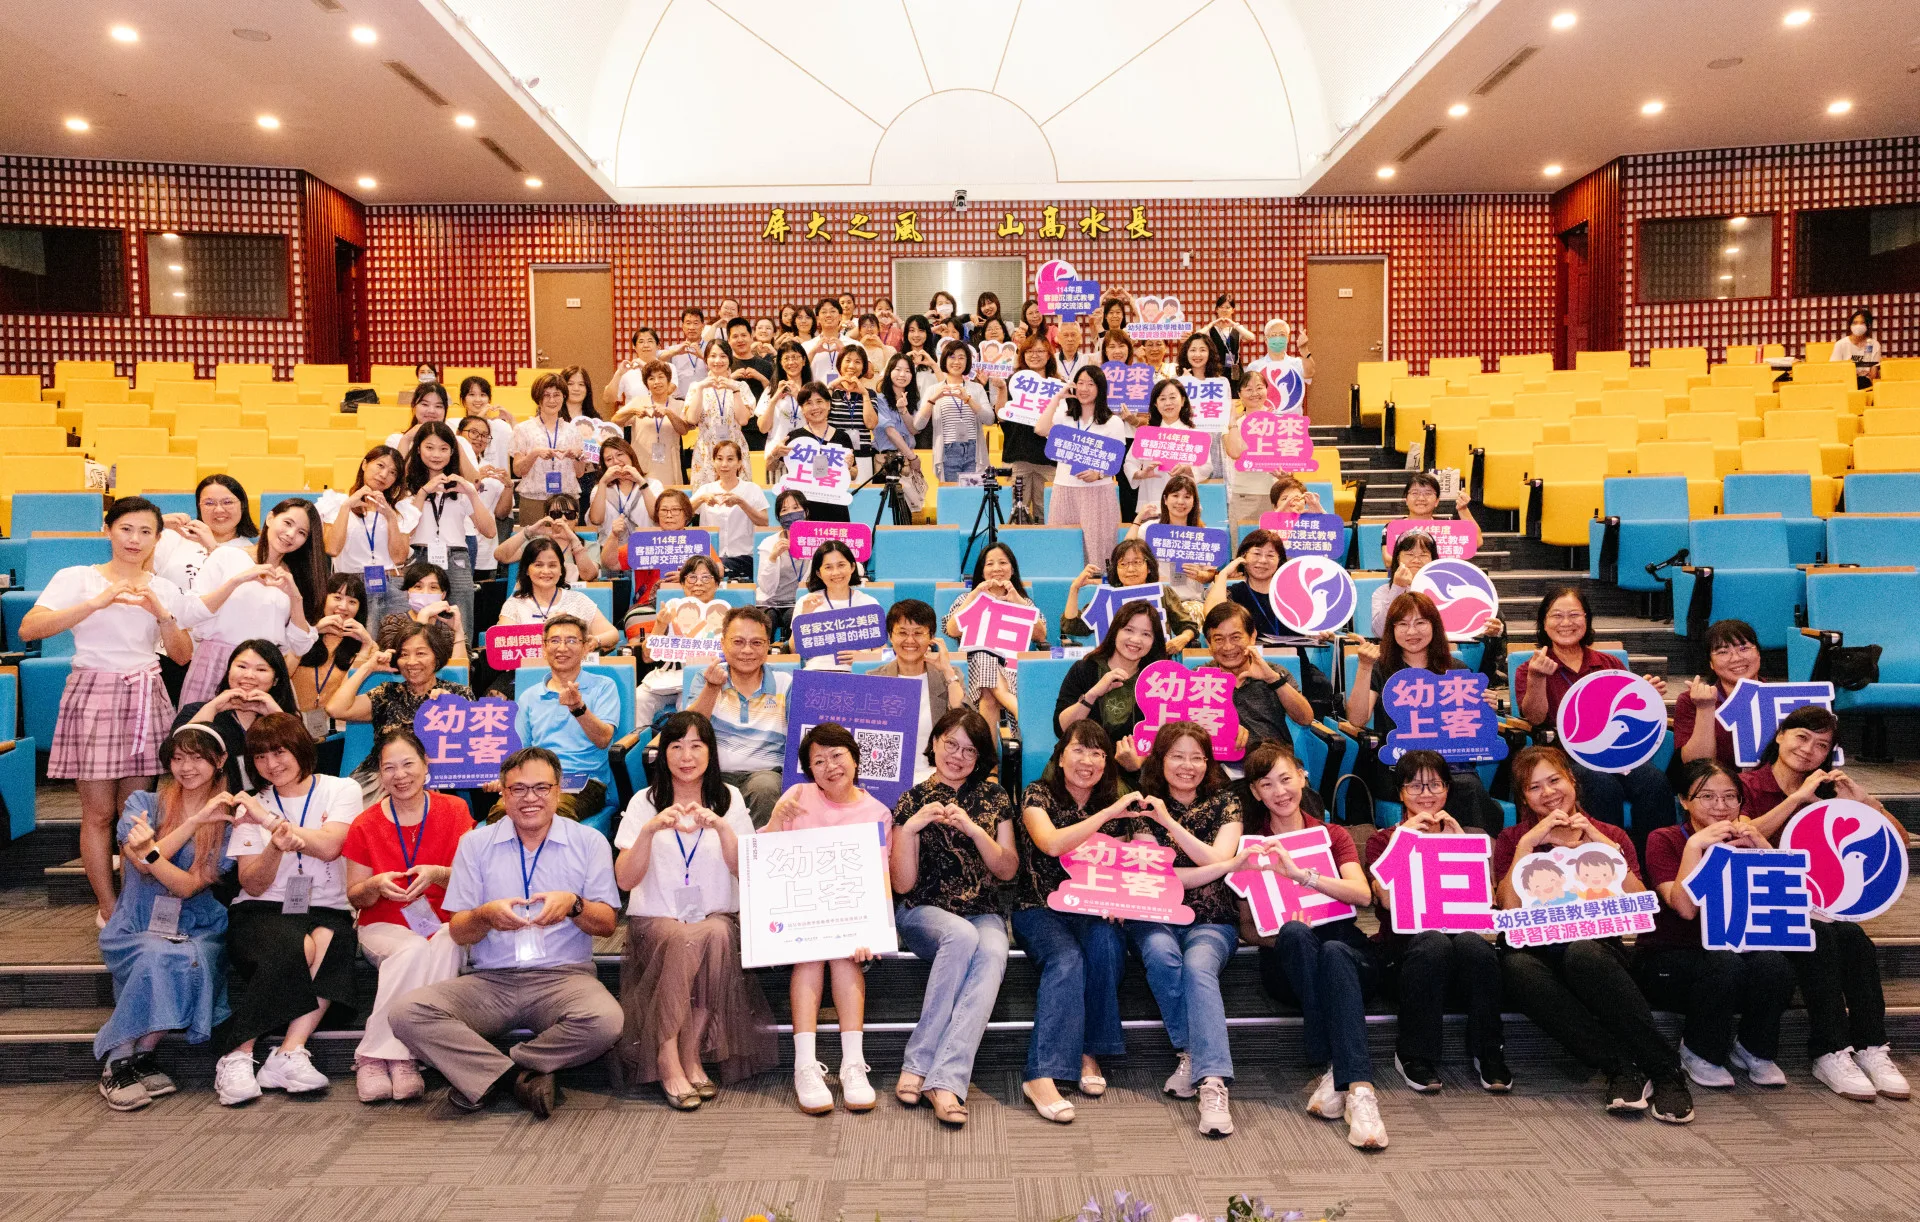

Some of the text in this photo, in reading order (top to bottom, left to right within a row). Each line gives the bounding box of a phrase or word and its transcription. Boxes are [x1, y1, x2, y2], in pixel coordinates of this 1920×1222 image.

[762, 205, 1153, 243] 屏大之風 山高水長
[1056, 286, 1083, 294] 114年度
[1103, 366, 1150, 382] 幼來
[1014, 375, 1063, 398] 幼來
[1107, 383, 1148, 400] 上客
[1158, 432, 1190, 442] 114年度
[1246, 417, 1304, 436] 幼來
[1054, 438, 1116, 462] 客語沉浸式教學
[1072, 433, 1104, 450] 114年度
[1140, 438, 1204, 454] 客語沉浸式教學
[1246, 437, 1304, 457] 上客
[790, 444, 846, 468] 幼來
[1056, 449, 1110, 471] 觀摩交流活動
[1142, 448, 1197, 463] 觀摩交流活動
[786, 464, 842, 488] 上客
[814, 528, 848, 538] 114年度
[1170, 530, 1205, 542] 114年度
[1284, 520, 1320, 530] 114年度
[635, 544, 704, 556] 客語沉浸式教學
[652, 535, 687, 545] 114年度
[1152, 537, 1220, 553] 客語沉浸式教學
[640, 554, 694, 566] 觀摩交流活
[1156, 547, 1216, 562] 觀摩交流活動
[800, 614, 880, 636] 客家文化之美與
[801, 626, 882, 649] 客語學習的相遇
[1145, 672, 1228, 705] 幼來
[1392, 676, 1481, 708] 幼來
[804, 688, 906, 717] 幼來上客
[423, 703, 509, 733] 幼來
[1143, 703, 1225, 737] 上客
[1396, 708, 1482, 740] 上客
[428, 734, 508, 764] 上客
[766, 841, 863, 879] 幼來
[1070, 841, 1166, 872] 幼來
[1070, 866, 1168, 899] 上客
[770, 874, 866, 915] 上客
[1496, 894, 1656, 930] 幼兒客語教學推動暨
[1508, 913, 1652, 946] 學習資源發展計畫
